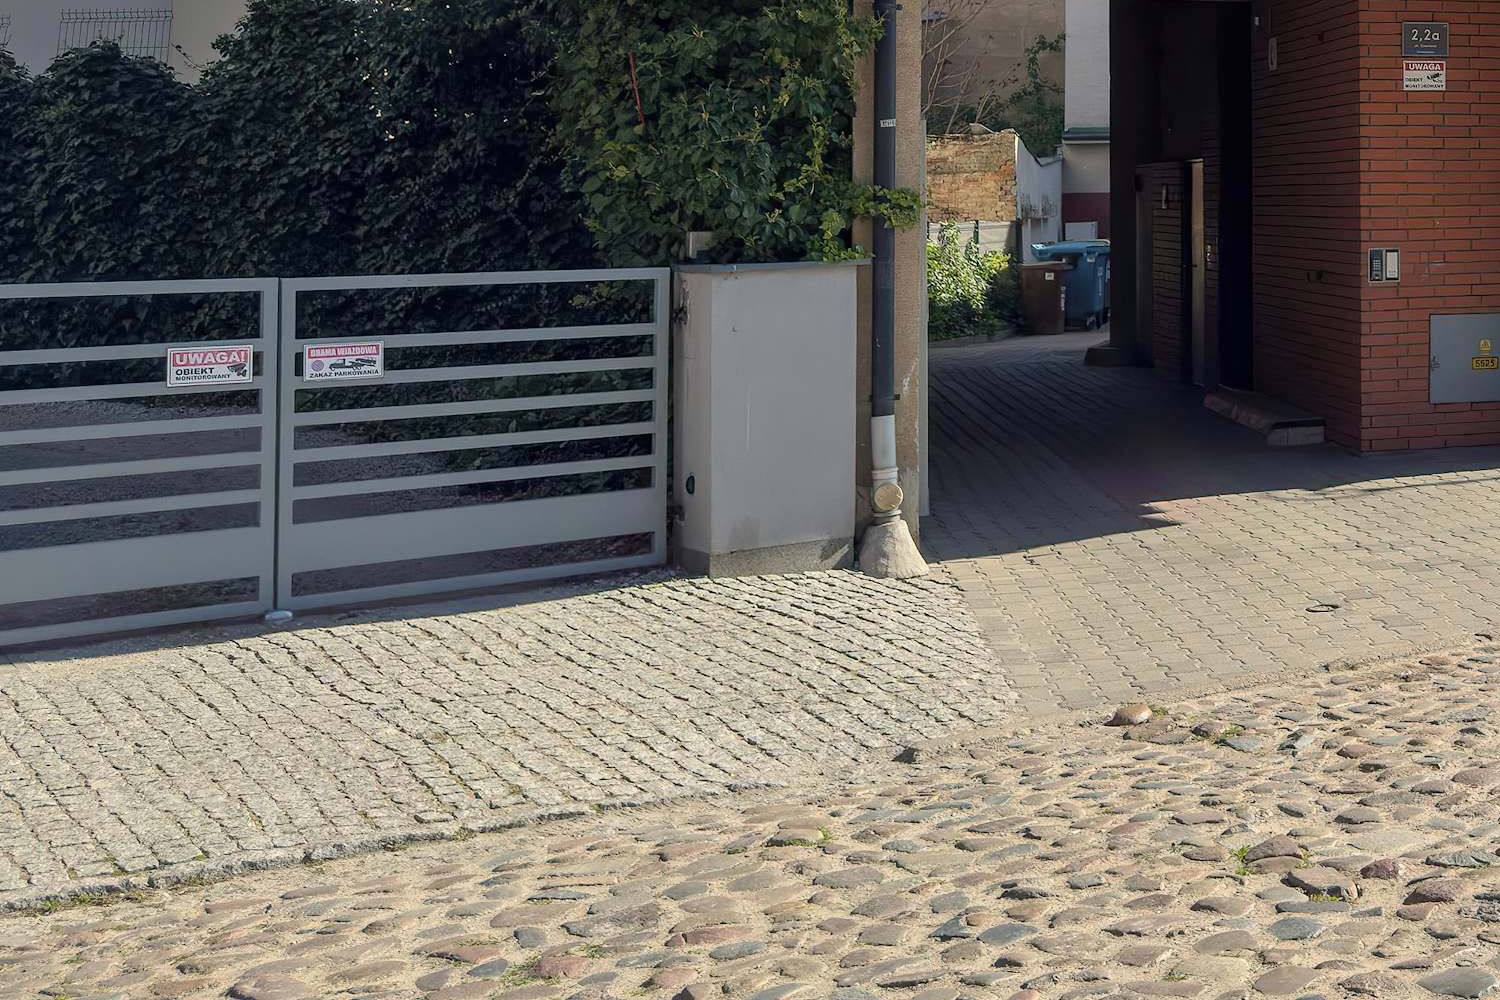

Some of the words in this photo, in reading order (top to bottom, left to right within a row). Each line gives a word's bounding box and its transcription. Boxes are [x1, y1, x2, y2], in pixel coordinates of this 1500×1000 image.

[1411, 29, 1440, 42] 2,2a
[1408, 63, 1441, 71] UWAGA
[175, 351, 246, 365] UWAGA!
[175, 367, 214, 376] OBIEKT
